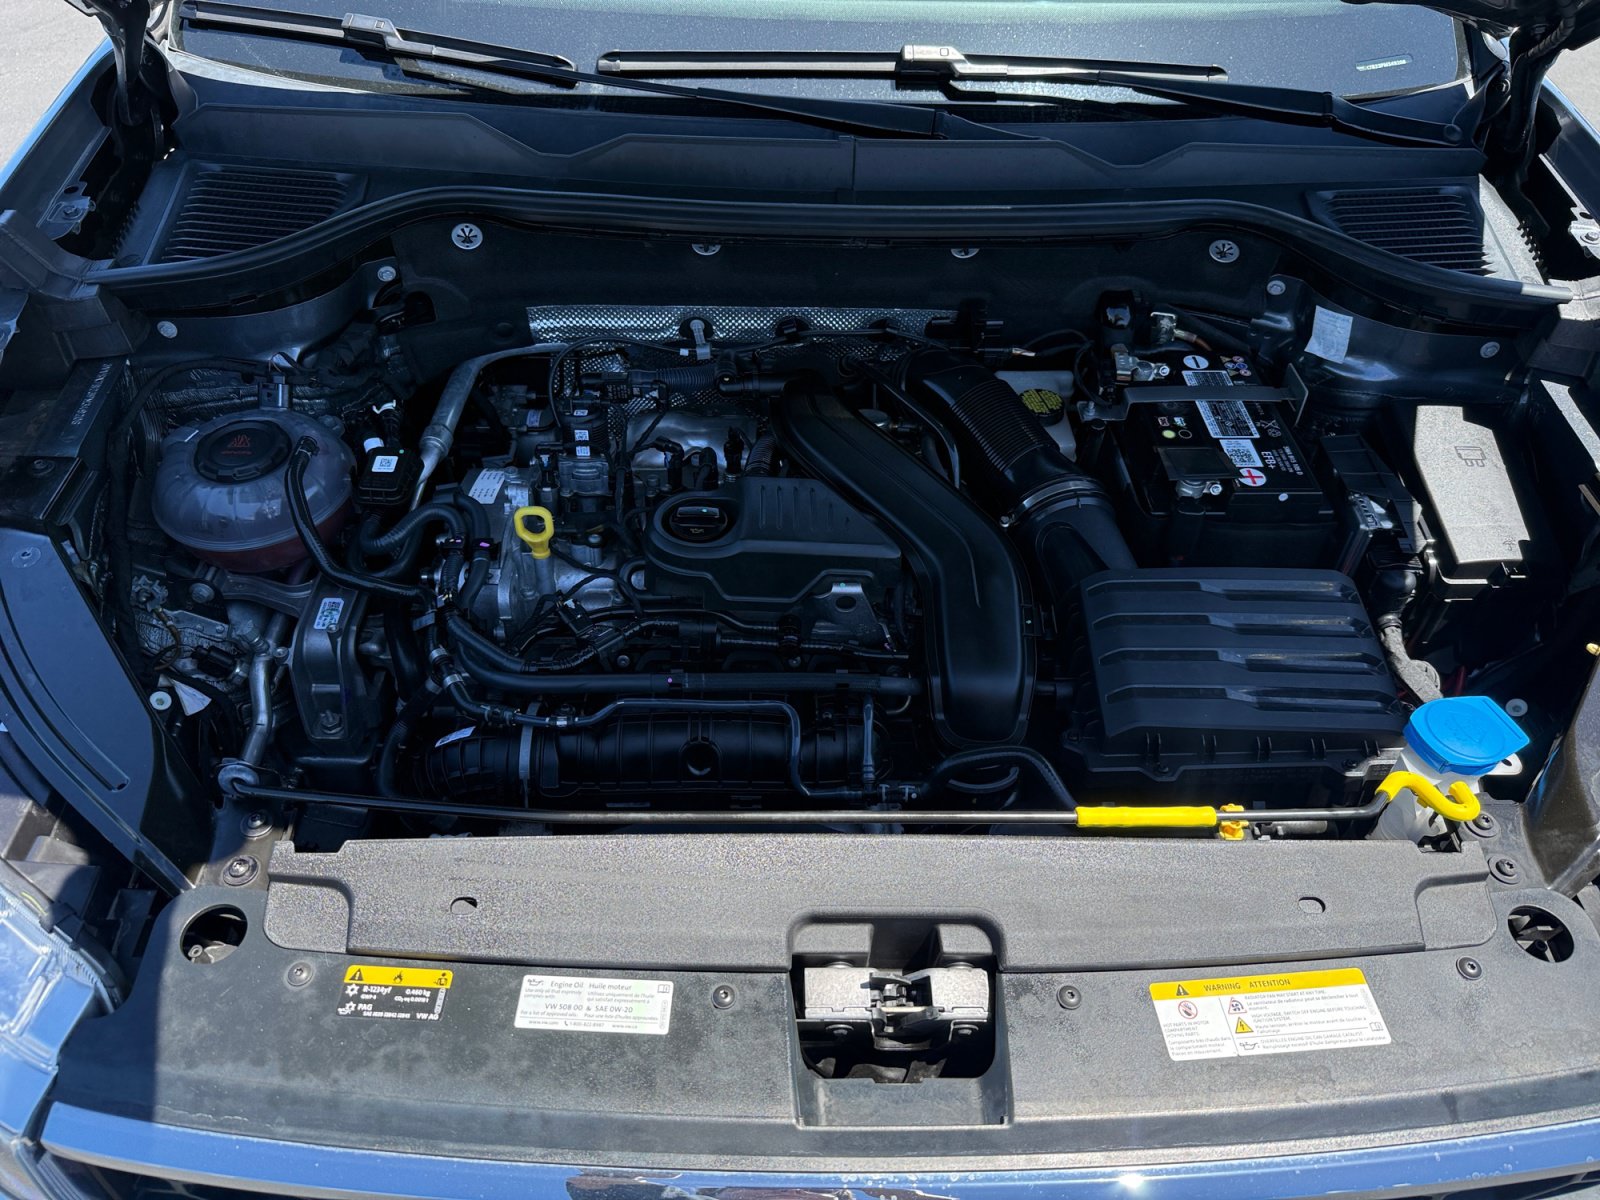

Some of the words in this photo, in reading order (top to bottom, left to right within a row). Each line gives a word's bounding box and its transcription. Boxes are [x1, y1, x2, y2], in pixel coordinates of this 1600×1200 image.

[1261, 451, 1276, 470] EFB+
[1204, 983, 1241, 991] WARNING
[1248, 979, 1291, 988] ATTENTION
